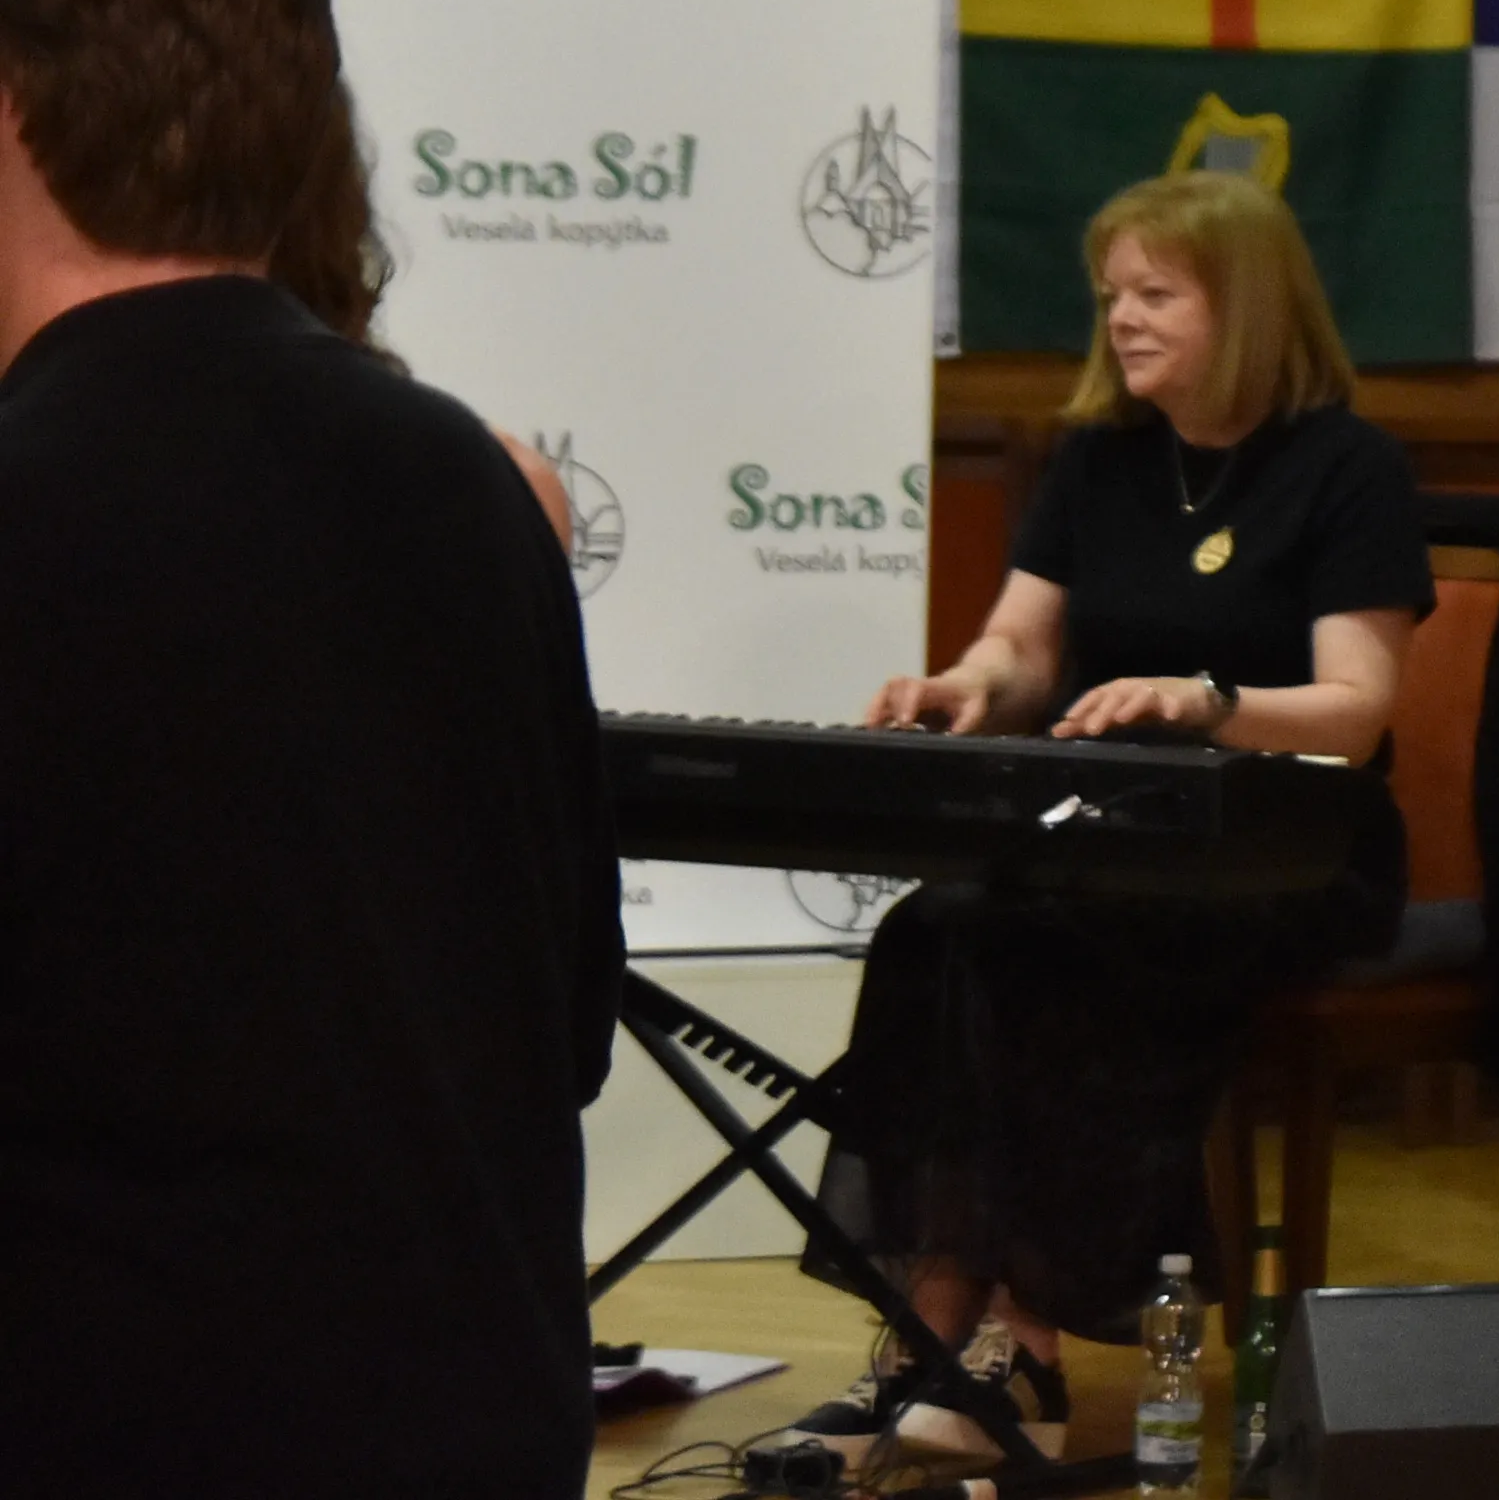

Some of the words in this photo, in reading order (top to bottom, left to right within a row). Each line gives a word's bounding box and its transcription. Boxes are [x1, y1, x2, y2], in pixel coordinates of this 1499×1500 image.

[412, 129, 579, 200] Sona
[593, 131, 697, 201] Sól
[727, 462, 887, 532] Sona
